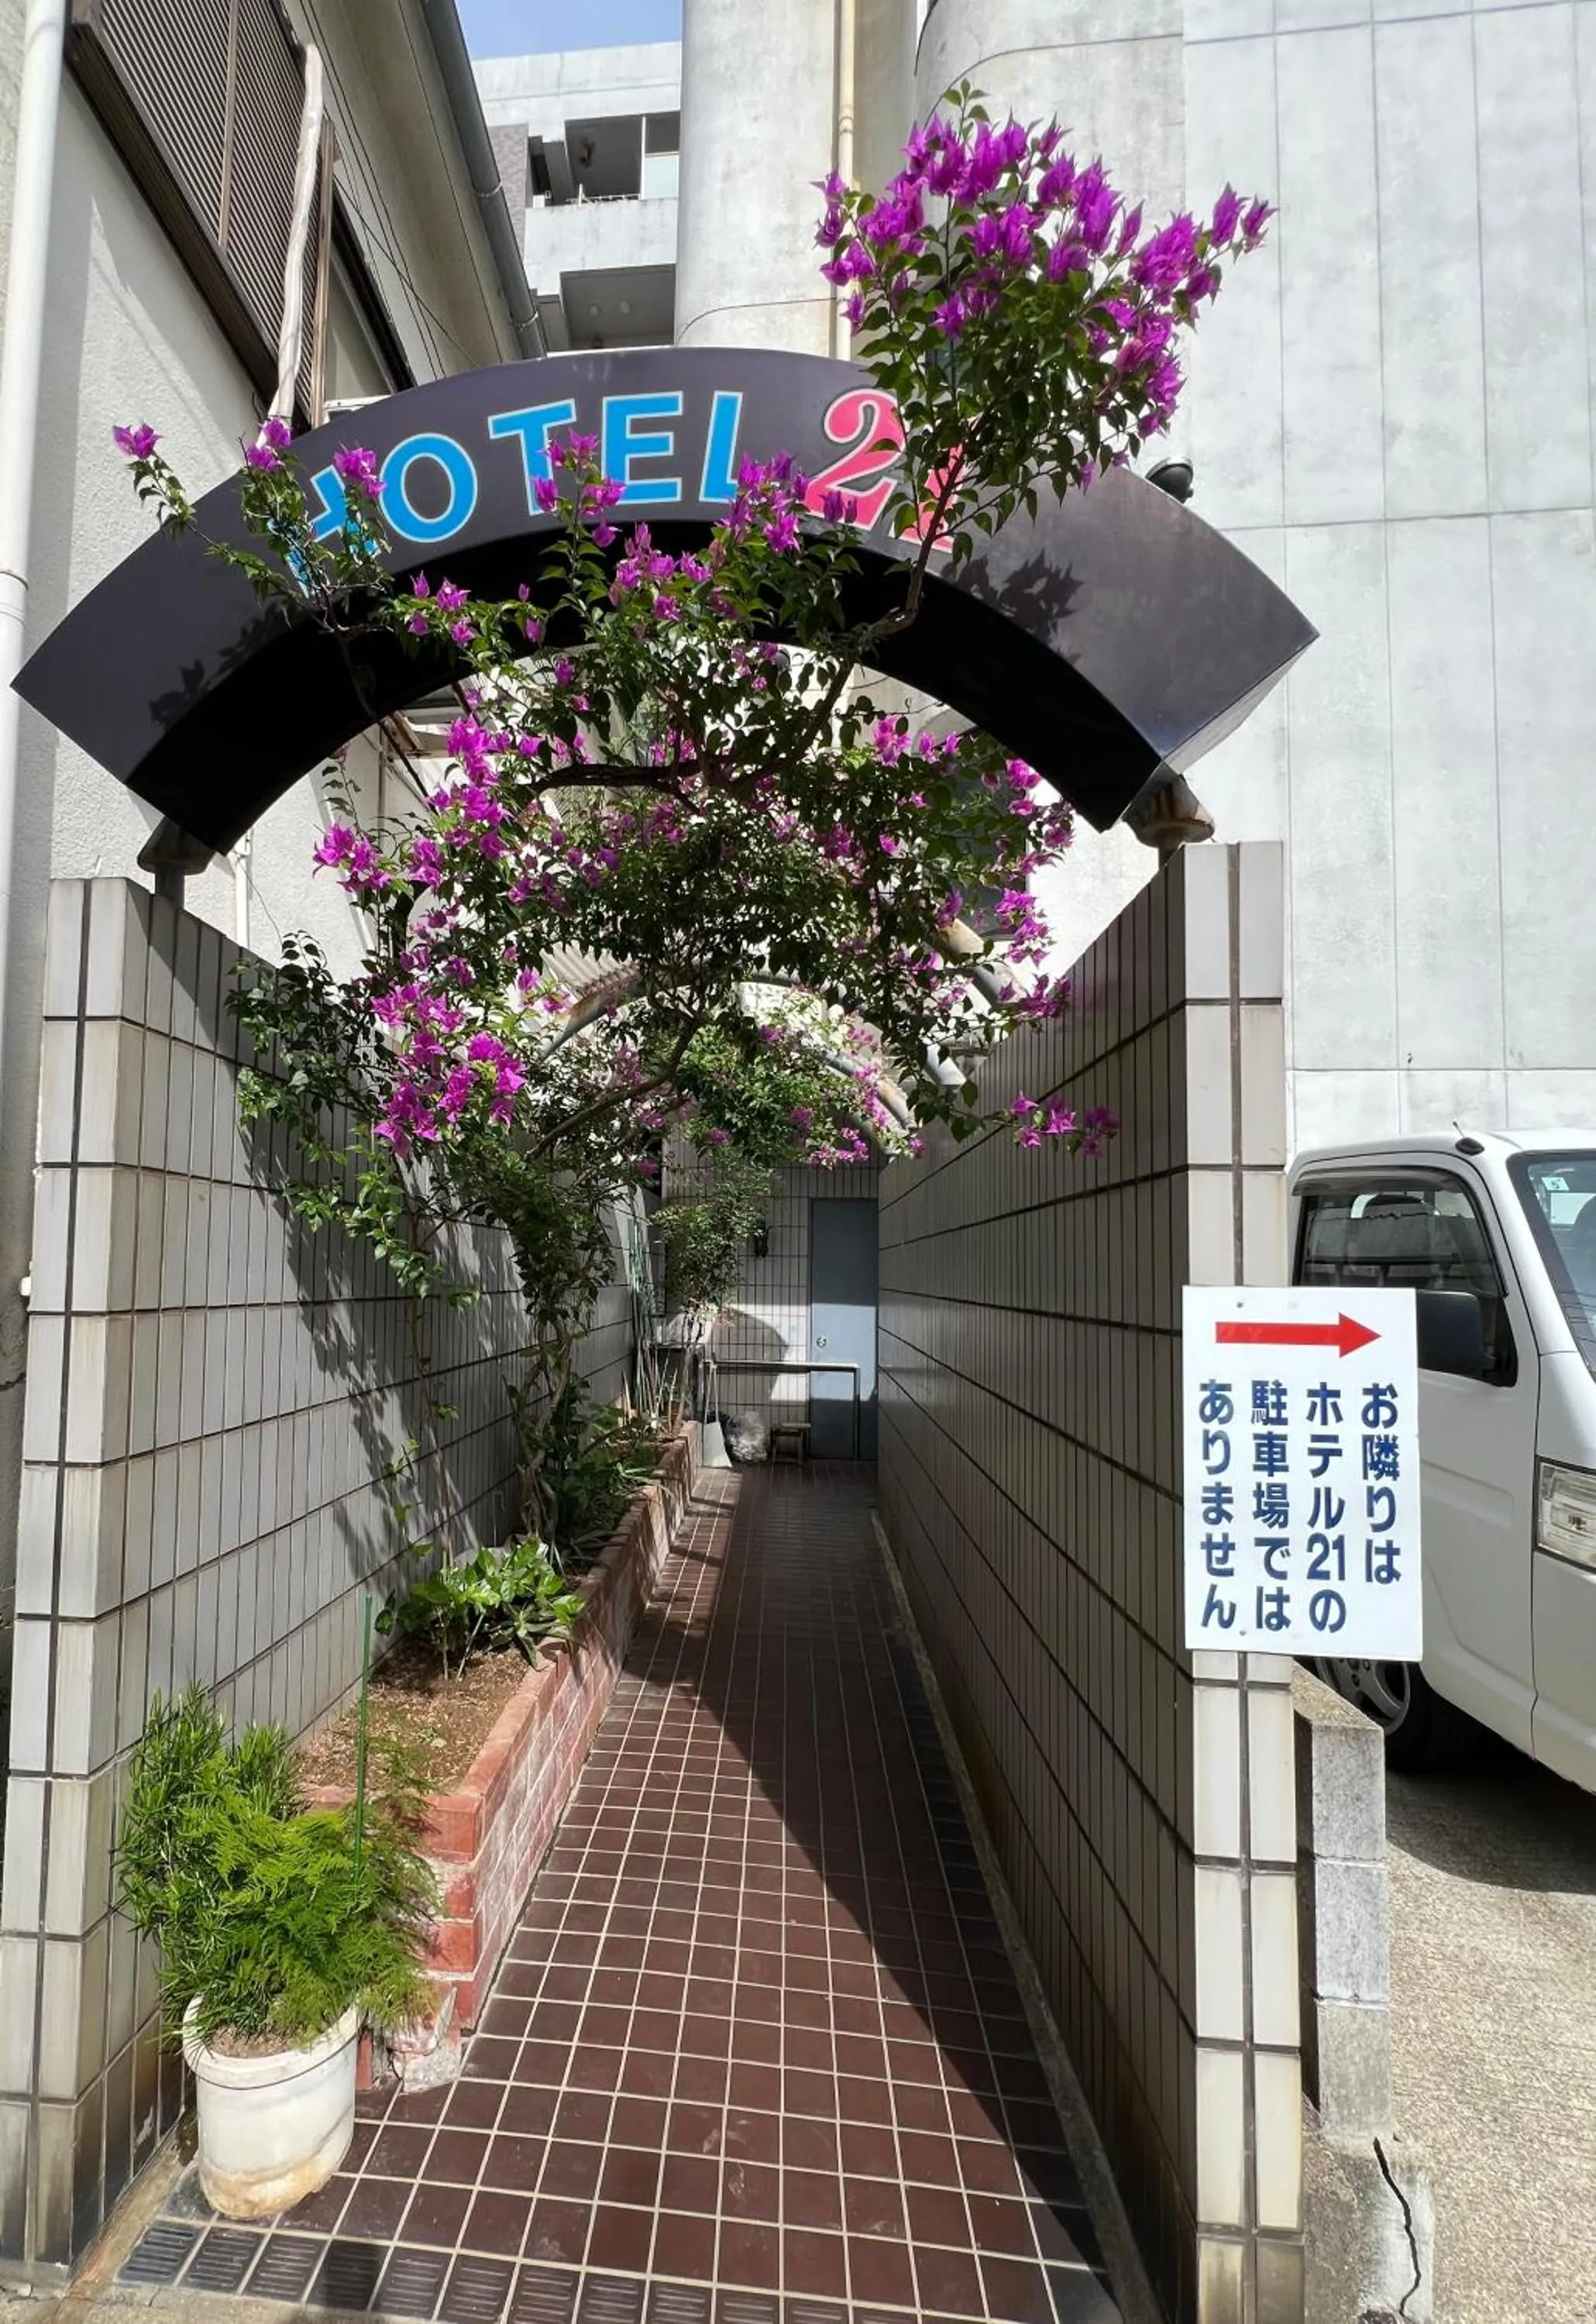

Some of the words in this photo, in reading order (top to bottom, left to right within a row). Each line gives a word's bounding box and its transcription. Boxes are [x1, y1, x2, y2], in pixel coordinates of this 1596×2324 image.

[1199, 1379, 1237, 1629] ありません
[1250, 1380, 1292, 1631] 駐車場では
[1305, 1381, 1347, 1634] ホテル21の
[1361, 1383, 1402, 1585] お隣りは
